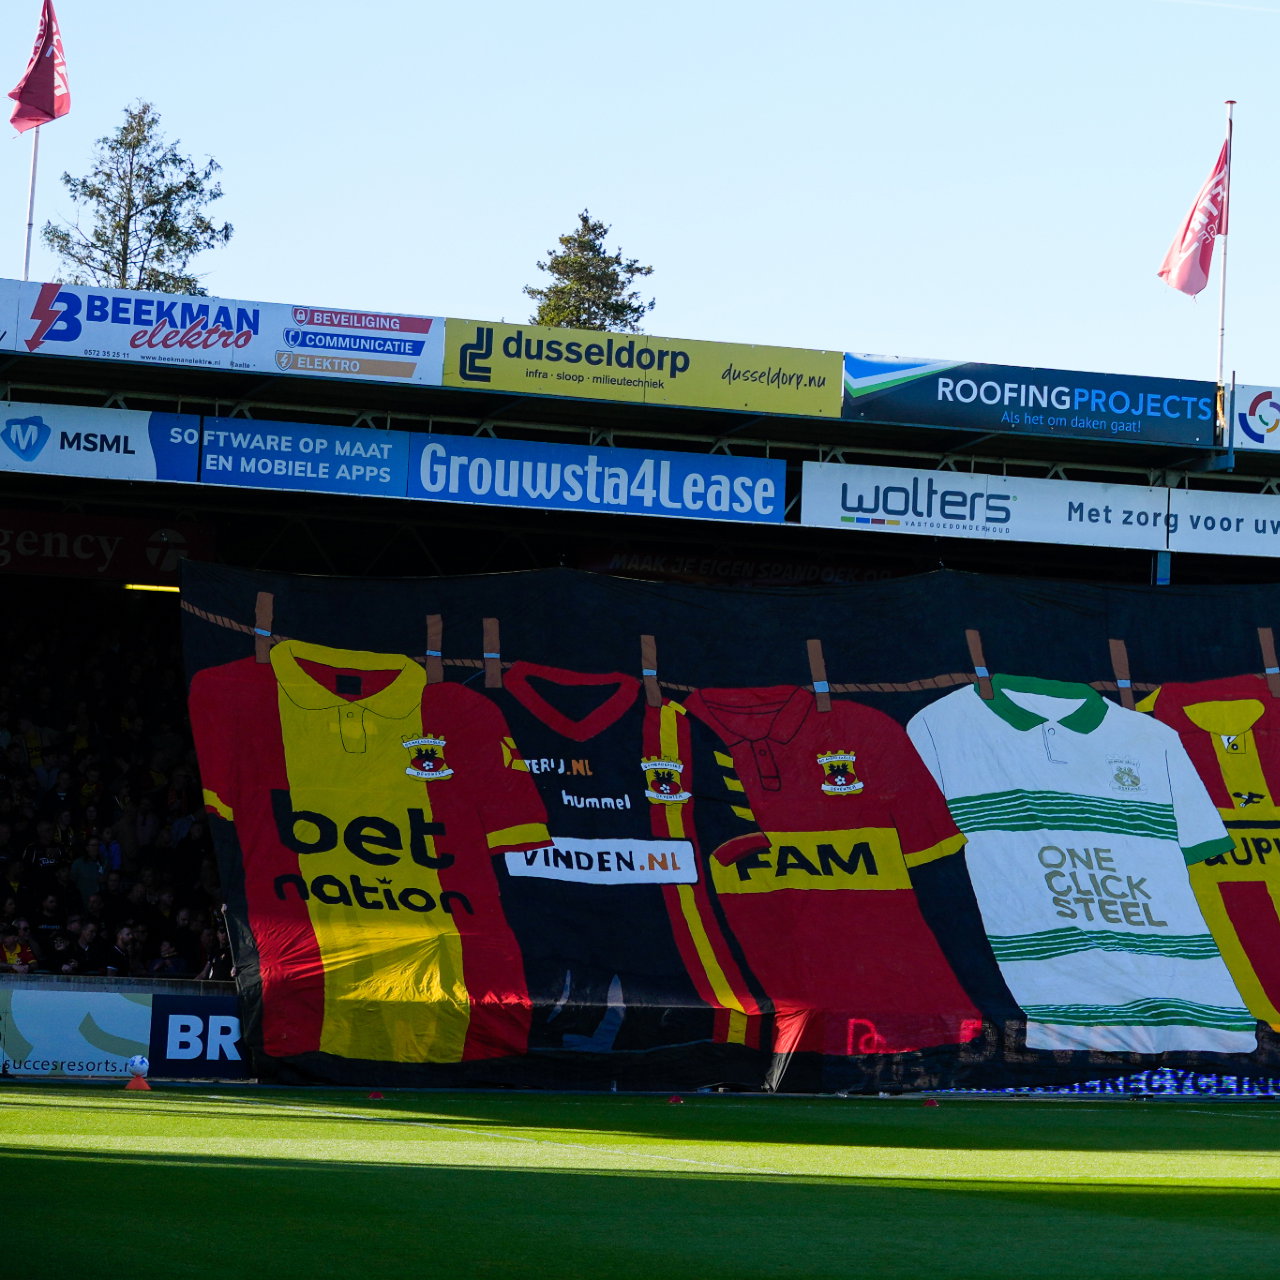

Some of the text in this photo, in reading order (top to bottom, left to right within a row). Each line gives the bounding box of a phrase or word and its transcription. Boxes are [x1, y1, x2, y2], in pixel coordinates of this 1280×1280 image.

[86, 294, 260, 336] BEEKMAN
[313, 312, 400, 330] BEVEILIGING
[130, 317, 253, 349] elektro
[306, 334, 413, 354] COMMUNICATIE
[297, 356, 360, 372] ELEKTRO
[502, 330, 690, 378] dusseldorp
[526, 368, 664, 390] infra sloop milieutechniek
[721, 363, 827, 390] dusseldorp.nu
[1001, 410, 1141, 434] Als het om daken gaat!
[60, 431, 136, 454] MSML
[169, 427, 392, 459] SOFTWARE OP MAAT
[205, 454, 391, 483] EN MOBIELE APPS
[420, 442, 775, 515] Grouwsta4Lease
[841, 477, 1011, 524] wolters
[1067, 501, 1112, 525] Met
[1122, 509, 1178, 534] zorg
[1190, 514, 1244, 533] voor
[562, 790, 631, 810] hummel
[270, 788, 456, 870] bet
[524, 848, 681, 872] VINDEN.NL
[735, 841, 879, 882] FAM
[1037, 844, 1116, 871] ONE
[273, 873, 474, 917] nation
[1044, 870, 1153, 901] CLICK
[1053, 895, 1168, 927] STEEL
